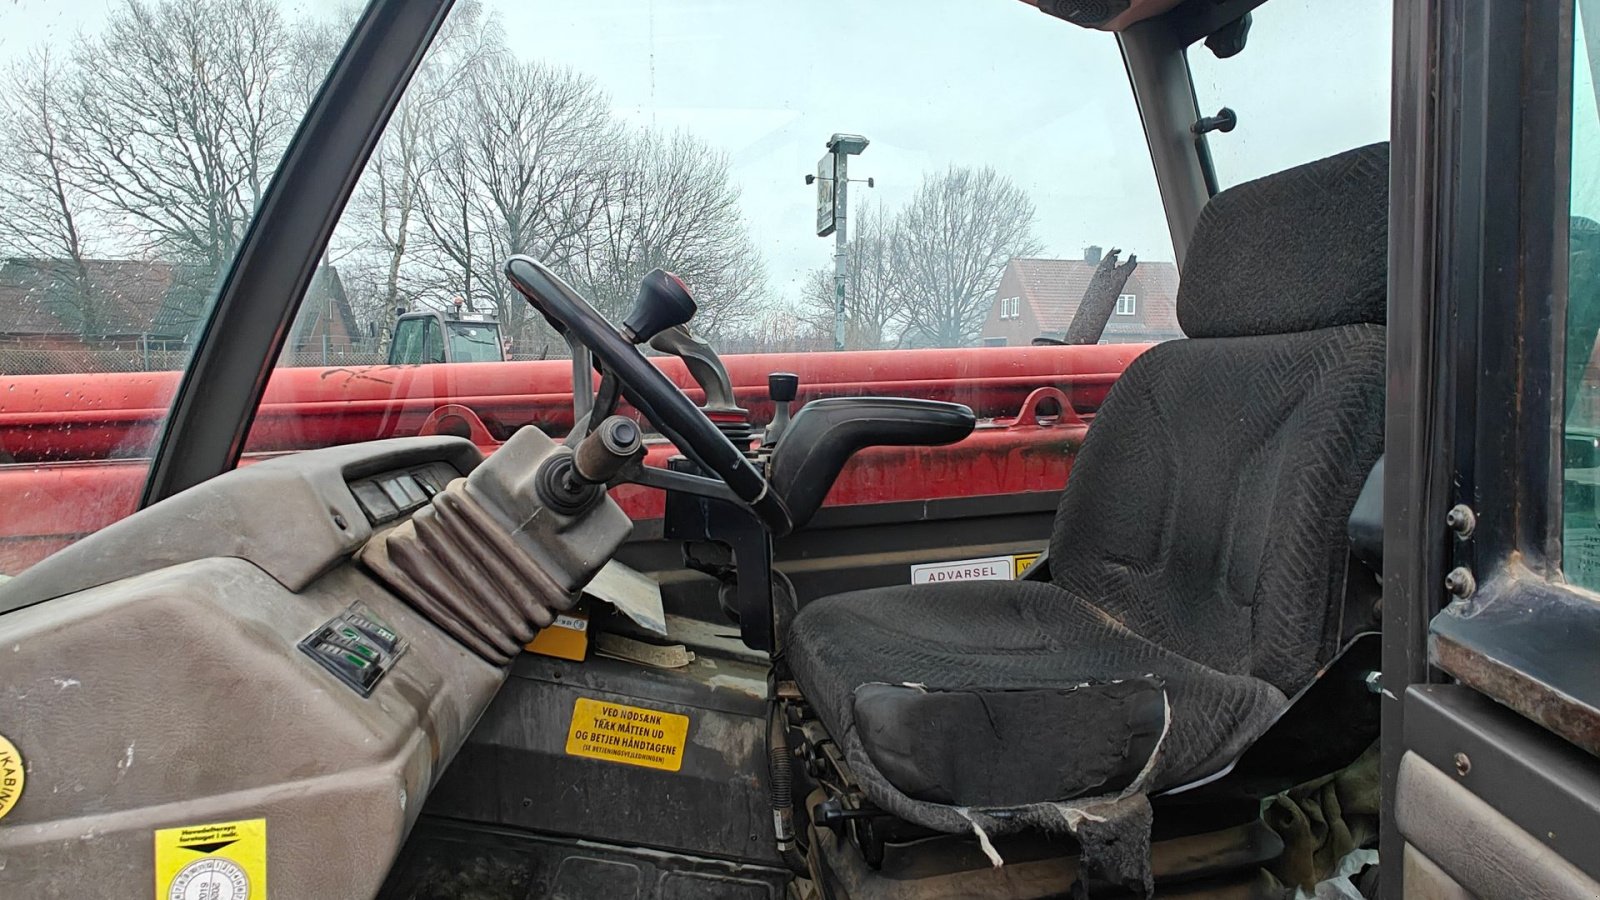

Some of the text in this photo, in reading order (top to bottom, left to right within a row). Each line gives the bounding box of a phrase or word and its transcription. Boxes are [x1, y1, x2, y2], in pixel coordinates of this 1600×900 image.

[928, 566, 998, 582] ADVARSEL
[602, 706, 662, 726] VED NØDSÆNK
[594, 719, 664, 739] TRÆK MÅTTEN UD
[575, 730, 677, 755] OG BETJEN HÅNDTAGENE
